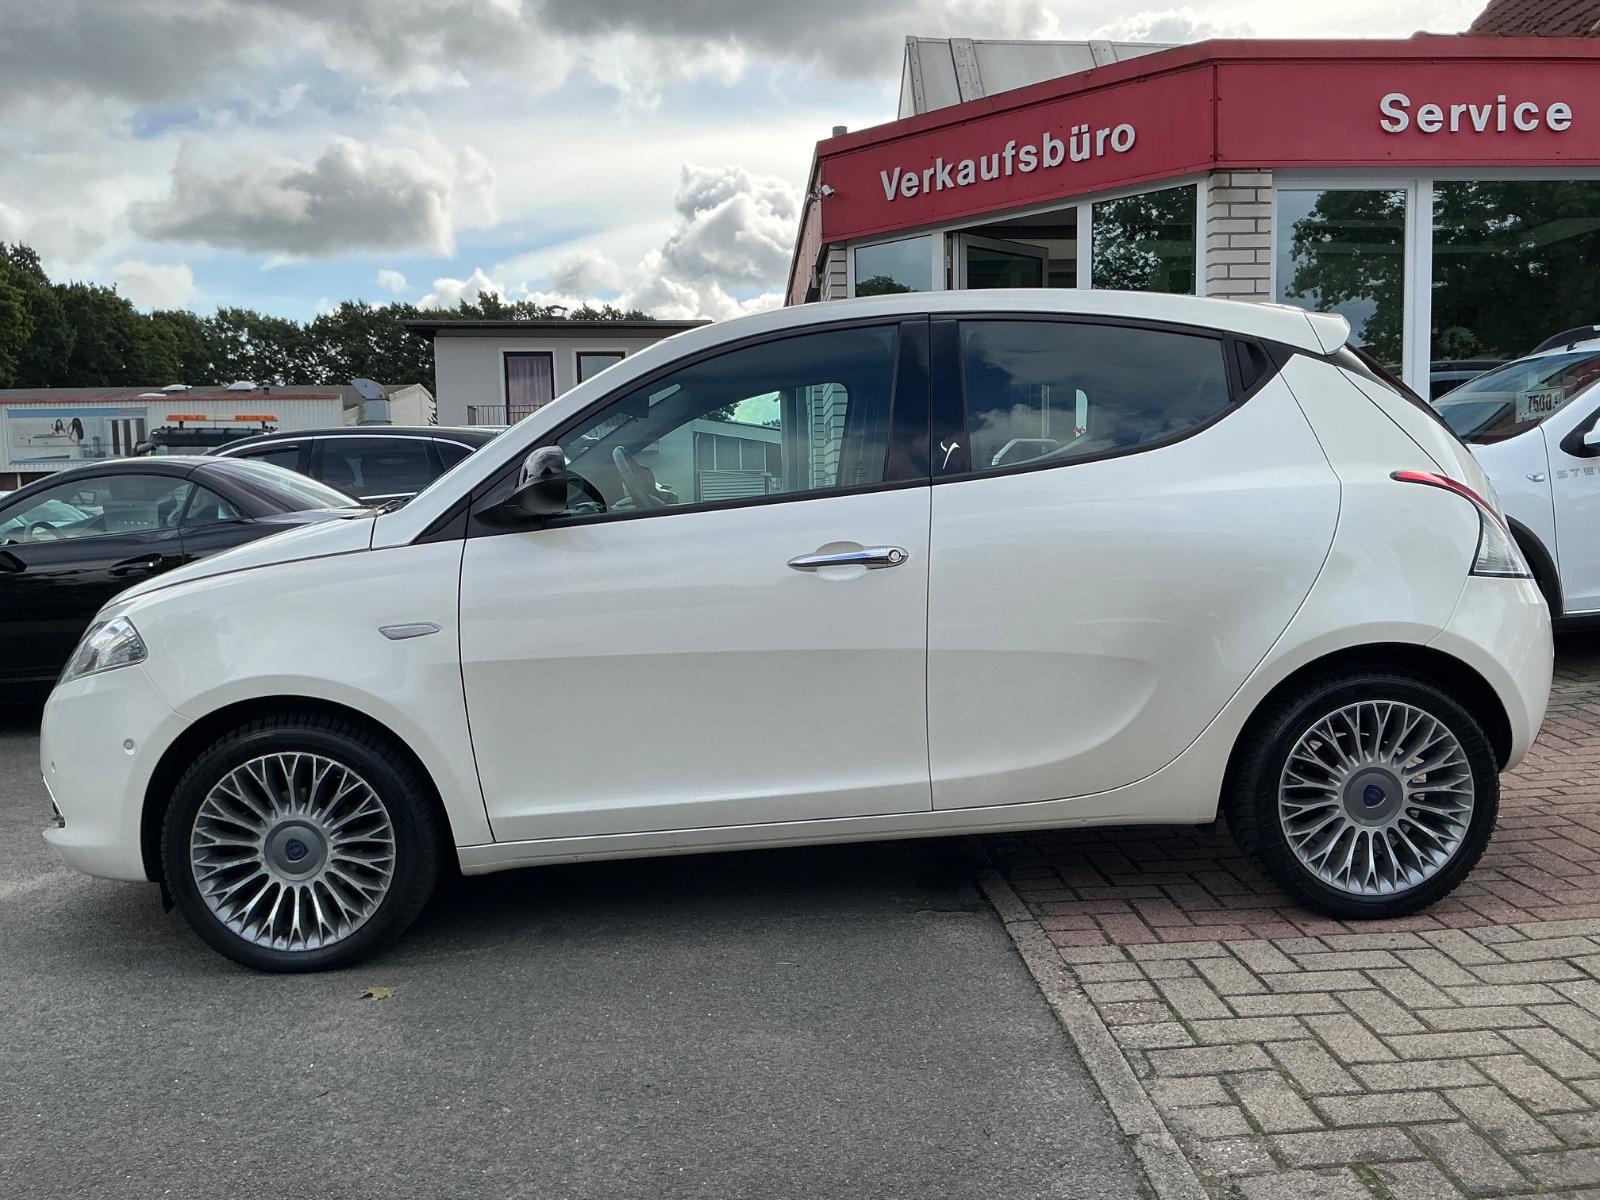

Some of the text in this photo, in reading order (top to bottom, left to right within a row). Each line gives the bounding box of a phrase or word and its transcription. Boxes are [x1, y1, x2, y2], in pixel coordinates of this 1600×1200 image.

[1379, 92, 1573, 133] Service
[880, 123, 1136, 201] Verkaufsbüro
[1557, 466, 1600, 479] STE
